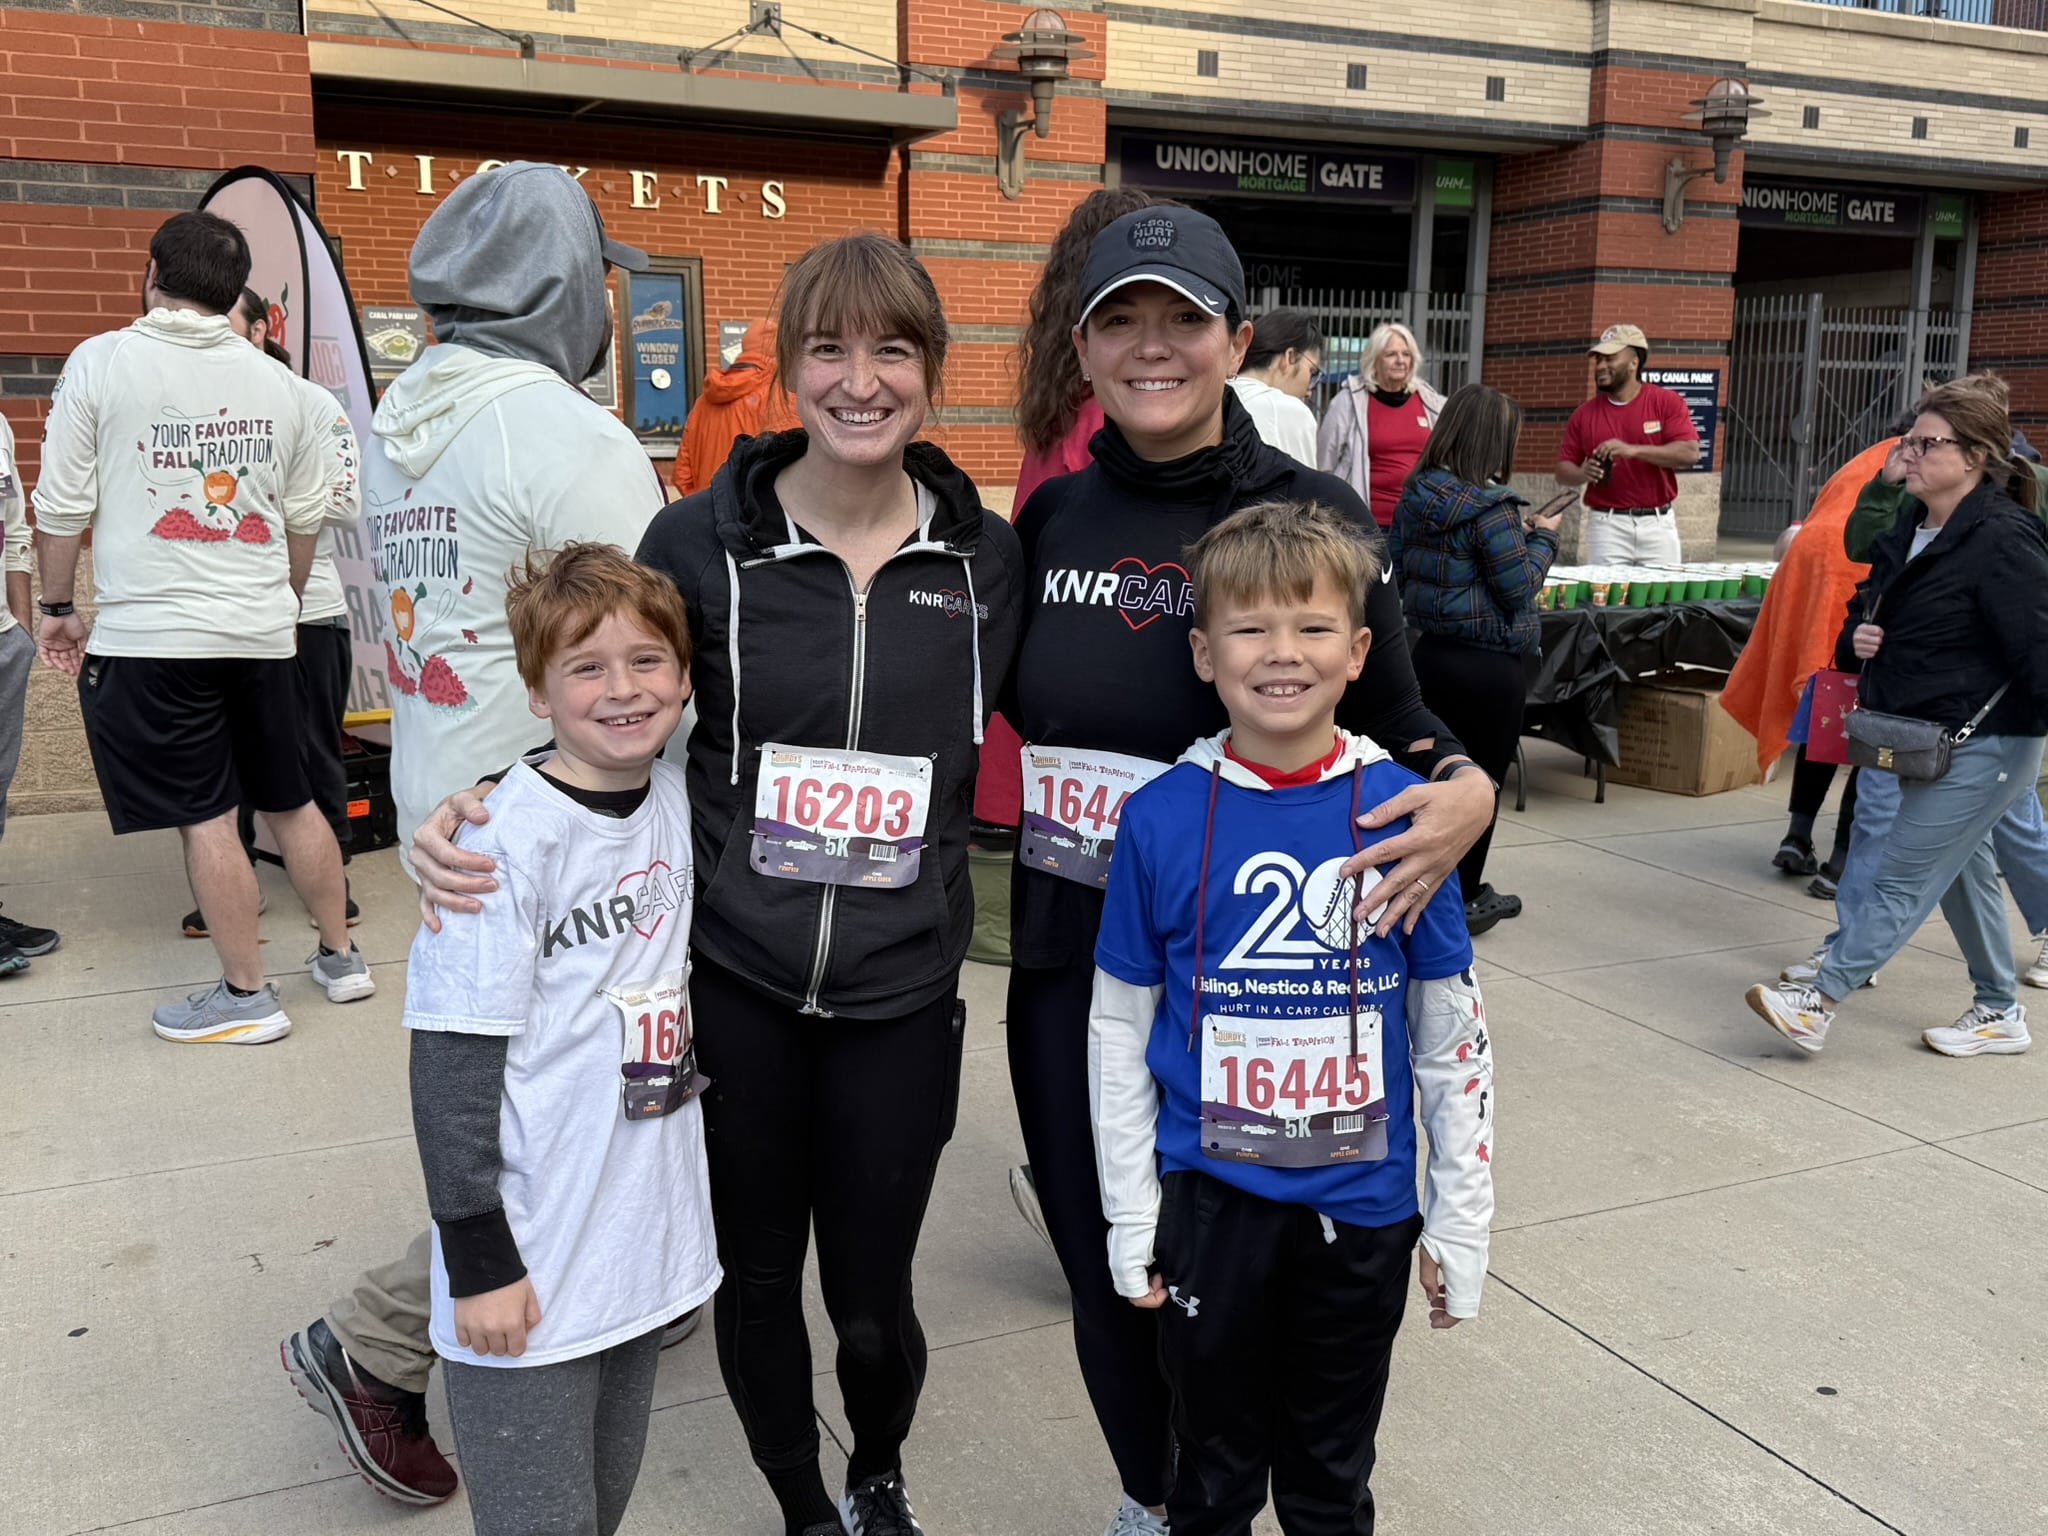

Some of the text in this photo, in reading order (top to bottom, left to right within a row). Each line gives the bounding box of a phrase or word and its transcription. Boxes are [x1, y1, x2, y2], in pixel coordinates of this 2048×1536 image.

[337, 149, 788, 219] TIETS
[1237, 175, 1307, 192] MORTGAGE
[1320, 162, 1383, 190] GATE
[1742, 187, 1895, 223] NIONHOME GATE
[1785, 211, 1837, 225] MORTGAGE
[1133, 227, 1174, 239] HURT
[1136, 237, 1171, 248] NOW
[636, 342, 679, 353] WINDOW
[640, 354, 676, 365] CLOSED
[1648, 372, 1661, 383] TO
[1662, 372, 1690, 383] CANAL
[1690, 373, 1714, 384] PARK
[151, 419, 273, 449] YOUR FAVORITE
[197, 438, 273, 468] TRADITION
[384, 506, 457, 539] FAVORITE
[384, 537, 459, 582] TRADITION
[773, 776, 913, 838] 16203
[1038, 775, 1134, 832] 1644
[825, 836, 851, 858] 5K
[1080, 836, 1102, 859] 5K
[1245, 978, 1310, 995] Nestico
[1312, 980, 1324, 995] &
[1379, 973, 1400, 992] LLC
[1219, 1003, 1251, 1014] HURT
[1256, 1004, 1268, 1014] IN
[1274, 1005, 1282, 1015] A
[1286, 1005, 1319, 1016] CAR?
[1323, 1004, 1351, 1016] CALL
[1292, 1036, 1335, 1047] TRADITION
[1220, 1053, 1370, 1111] 16445
[1285, 1116, 1313, 1139] 5K
